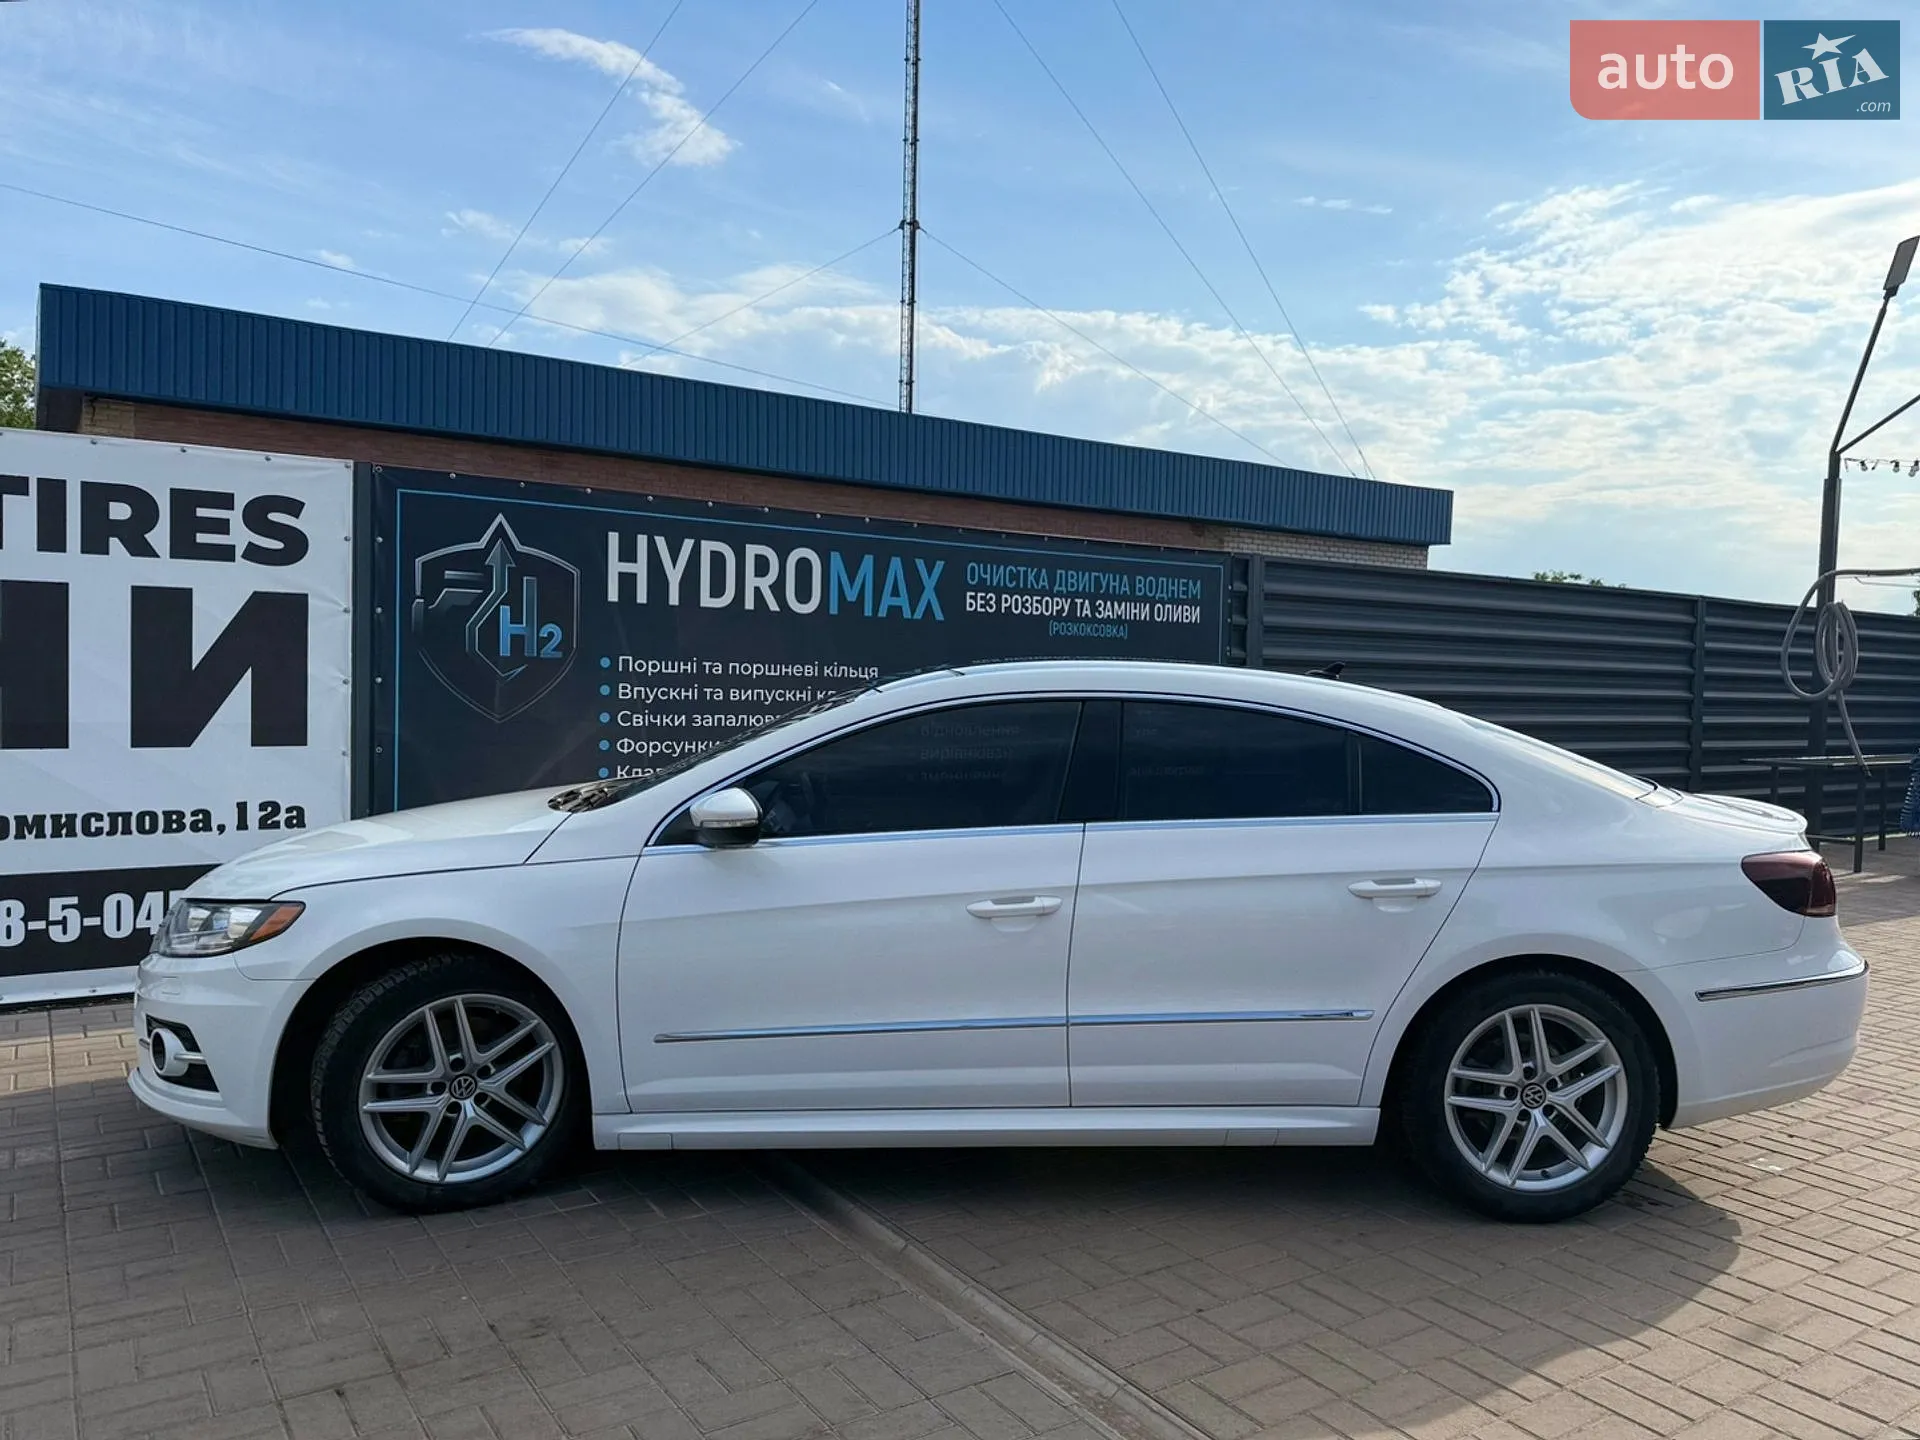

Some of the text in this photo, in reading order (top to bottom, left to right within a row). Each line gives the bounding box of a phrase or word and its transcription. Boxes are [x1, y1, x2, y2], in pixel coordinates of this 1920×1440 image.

[606, 530, 946, 622] HYDROMAX
[966, 562, 1201, 600] ОЧИСТКА ДВИГУНА ВОДНЕМ
[500, 576, 563, 658] H2
[966, 591, 1201, 624] БЕЗ РОЗБОРУ ТА ЗАМІНИ ОЛИВИ
[1049, 620, 1128, 640] (РОЗКОКСОВКА)
[617, 655, 879, 680] Поршні та поршневі кільця
[617, 682, 698, 704] Впускні
[703, 687, 724, 701] та
[729, 686, 812, 705] випускні
[616, 709, 782, 728] Свічки запалюв
[0, 889, 184, 948] 8-5-04
